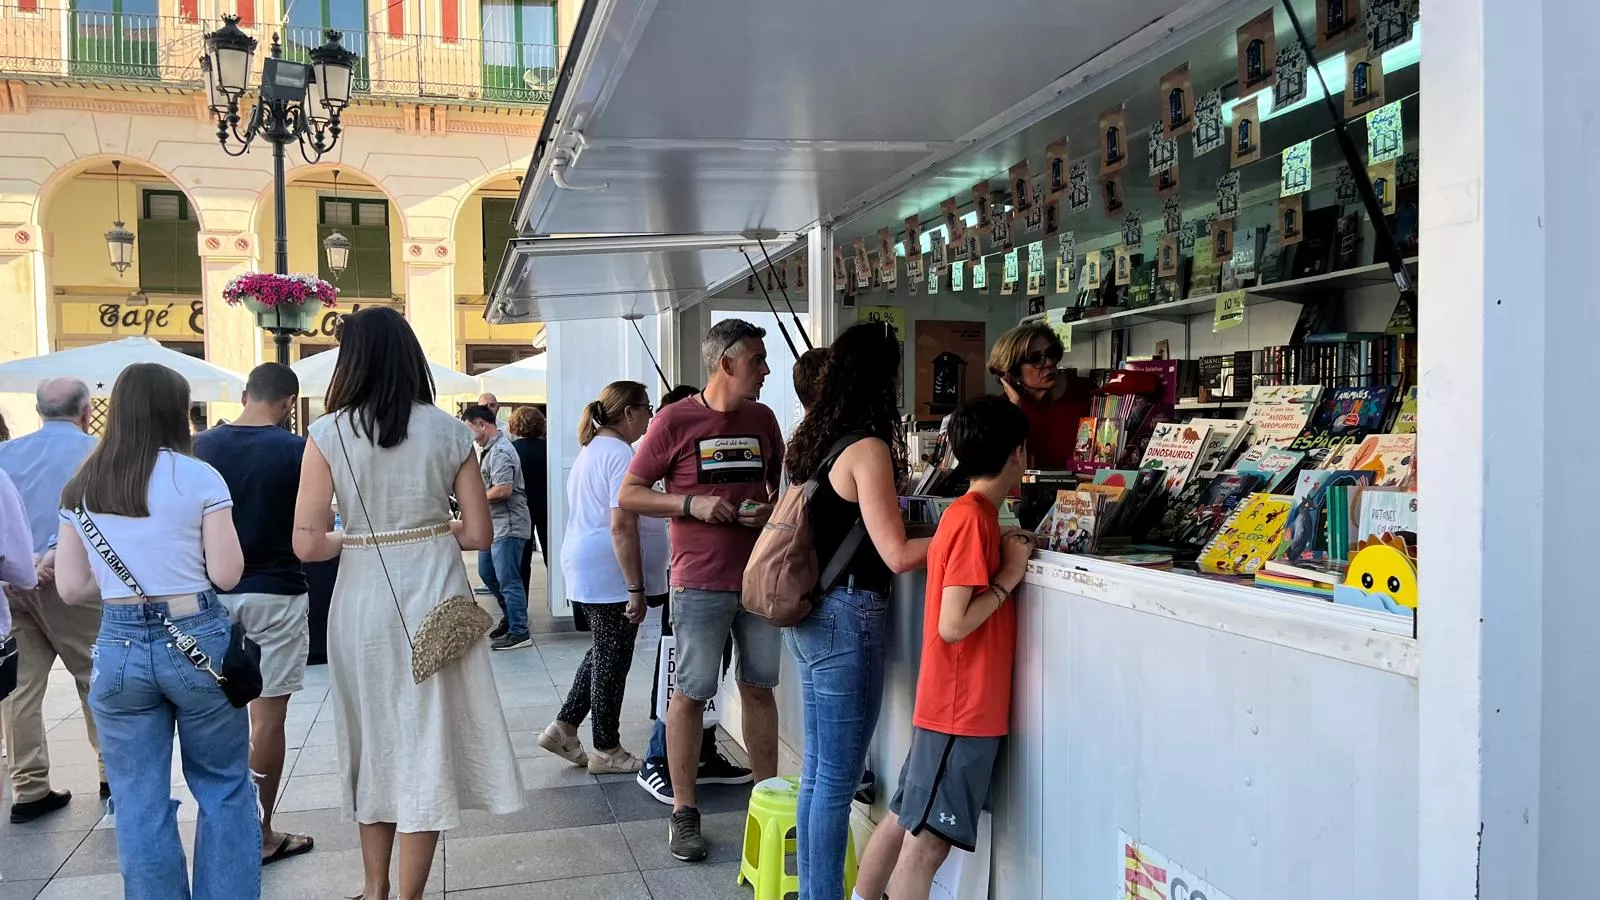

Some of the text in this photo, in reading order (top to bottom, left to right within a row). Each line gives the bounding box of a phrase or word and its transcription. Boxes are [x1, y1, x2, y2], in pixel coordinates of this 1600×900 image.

[1223, 297, 1232, 311] 10
[98, 303, 174, 335] Café
[867, 311, 881, 323] 10
[1260, 422, 1300, 430] AEROPUERTOS
[1290, 434, 1357, 450] ESPACIO
[1147, 447, 1195, 460] DINOSAURIOS
